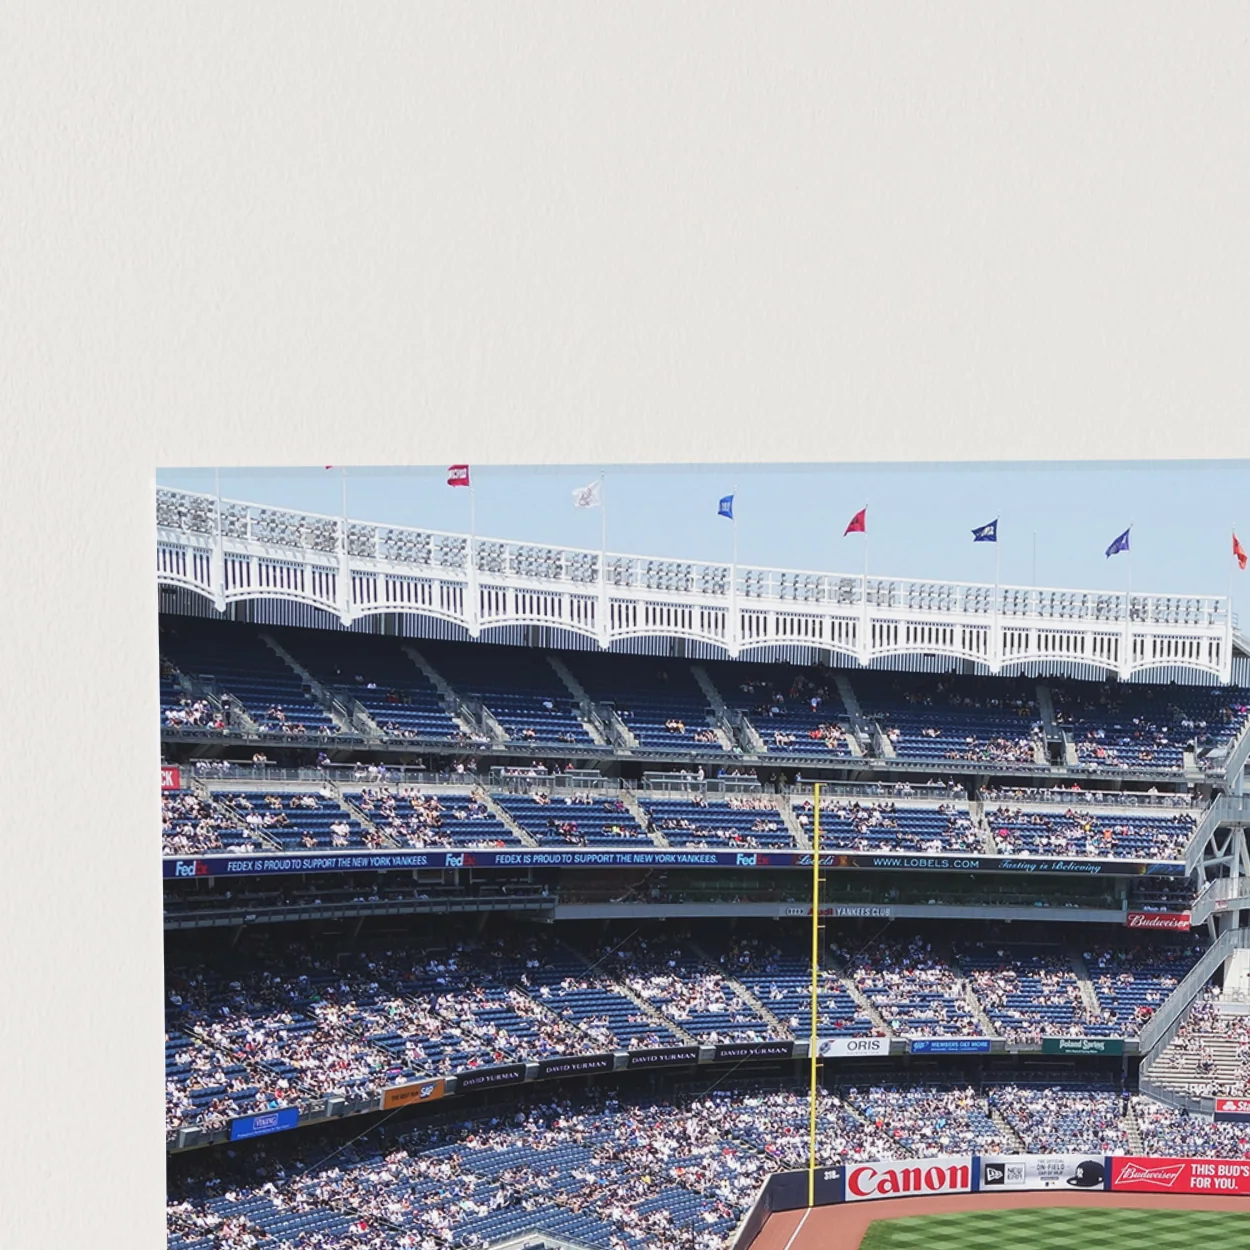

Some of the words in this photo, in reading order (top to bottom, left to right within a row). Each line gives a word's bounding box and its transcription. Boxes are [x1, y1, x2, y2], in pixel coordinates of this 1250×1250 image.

[175, 860, 208, 876] FedEx
[228, 861, 252, 872] FEDEX
[254, 860, 262, 870] IS
[264, 860, 290, 870] PROUD
[291, 859, 301, 869] TO
[303, 858, 336, 868] SUPPORT
[338, 858, 350, 868] THE
[352, 857, 368, 867] NEW
[370, 856, 391, 866] YORK
[445, 854, 476, 866] FedEx
[495, 854, 522, 864] FEDEX
[523, 854, 531, 864] IS
[533, 854, 560, 864] PROUD
[562, 854, 572, 863] TO
[574, 854, 614, 864] SUPPORT
[616, 854, 631, 863] THE
[633, 854, 652, 864] NEW
[654, 854, 676, 864] YORK
[836, 908, 870, 916] YANKEES
[872, 908, 891, 916] CLUB
[1128, 912, 1190, 929] Budweiser
[720, 1049, 748, 1058] DAVID
[749, 1047, 788, 1056] YURMAN
[847, 1040, 880, 1052] ORIS
[632, 1054, 658, 1064] DAVID
[660, 1052, 696, 1062] YURMAN
[546, 1064, 570, 1074] DAVID
[572, 1060, 608, 1070] YURMAN
[462, 1076, 485, 1087] DAVID
[486, 1072, 519, 1082] YURMAN
[1123, 1167, 1178, 1180] Budweiser
[1191, 1164, 1215, 1176] THIS
[1218, 1164, 1250, 1177] BUD'S
[848, 1164, 970, 1197] Canon
[1190, 1178, 1211, 1188] FOR
[1214, 1178, 1238, 1190] YOU.
